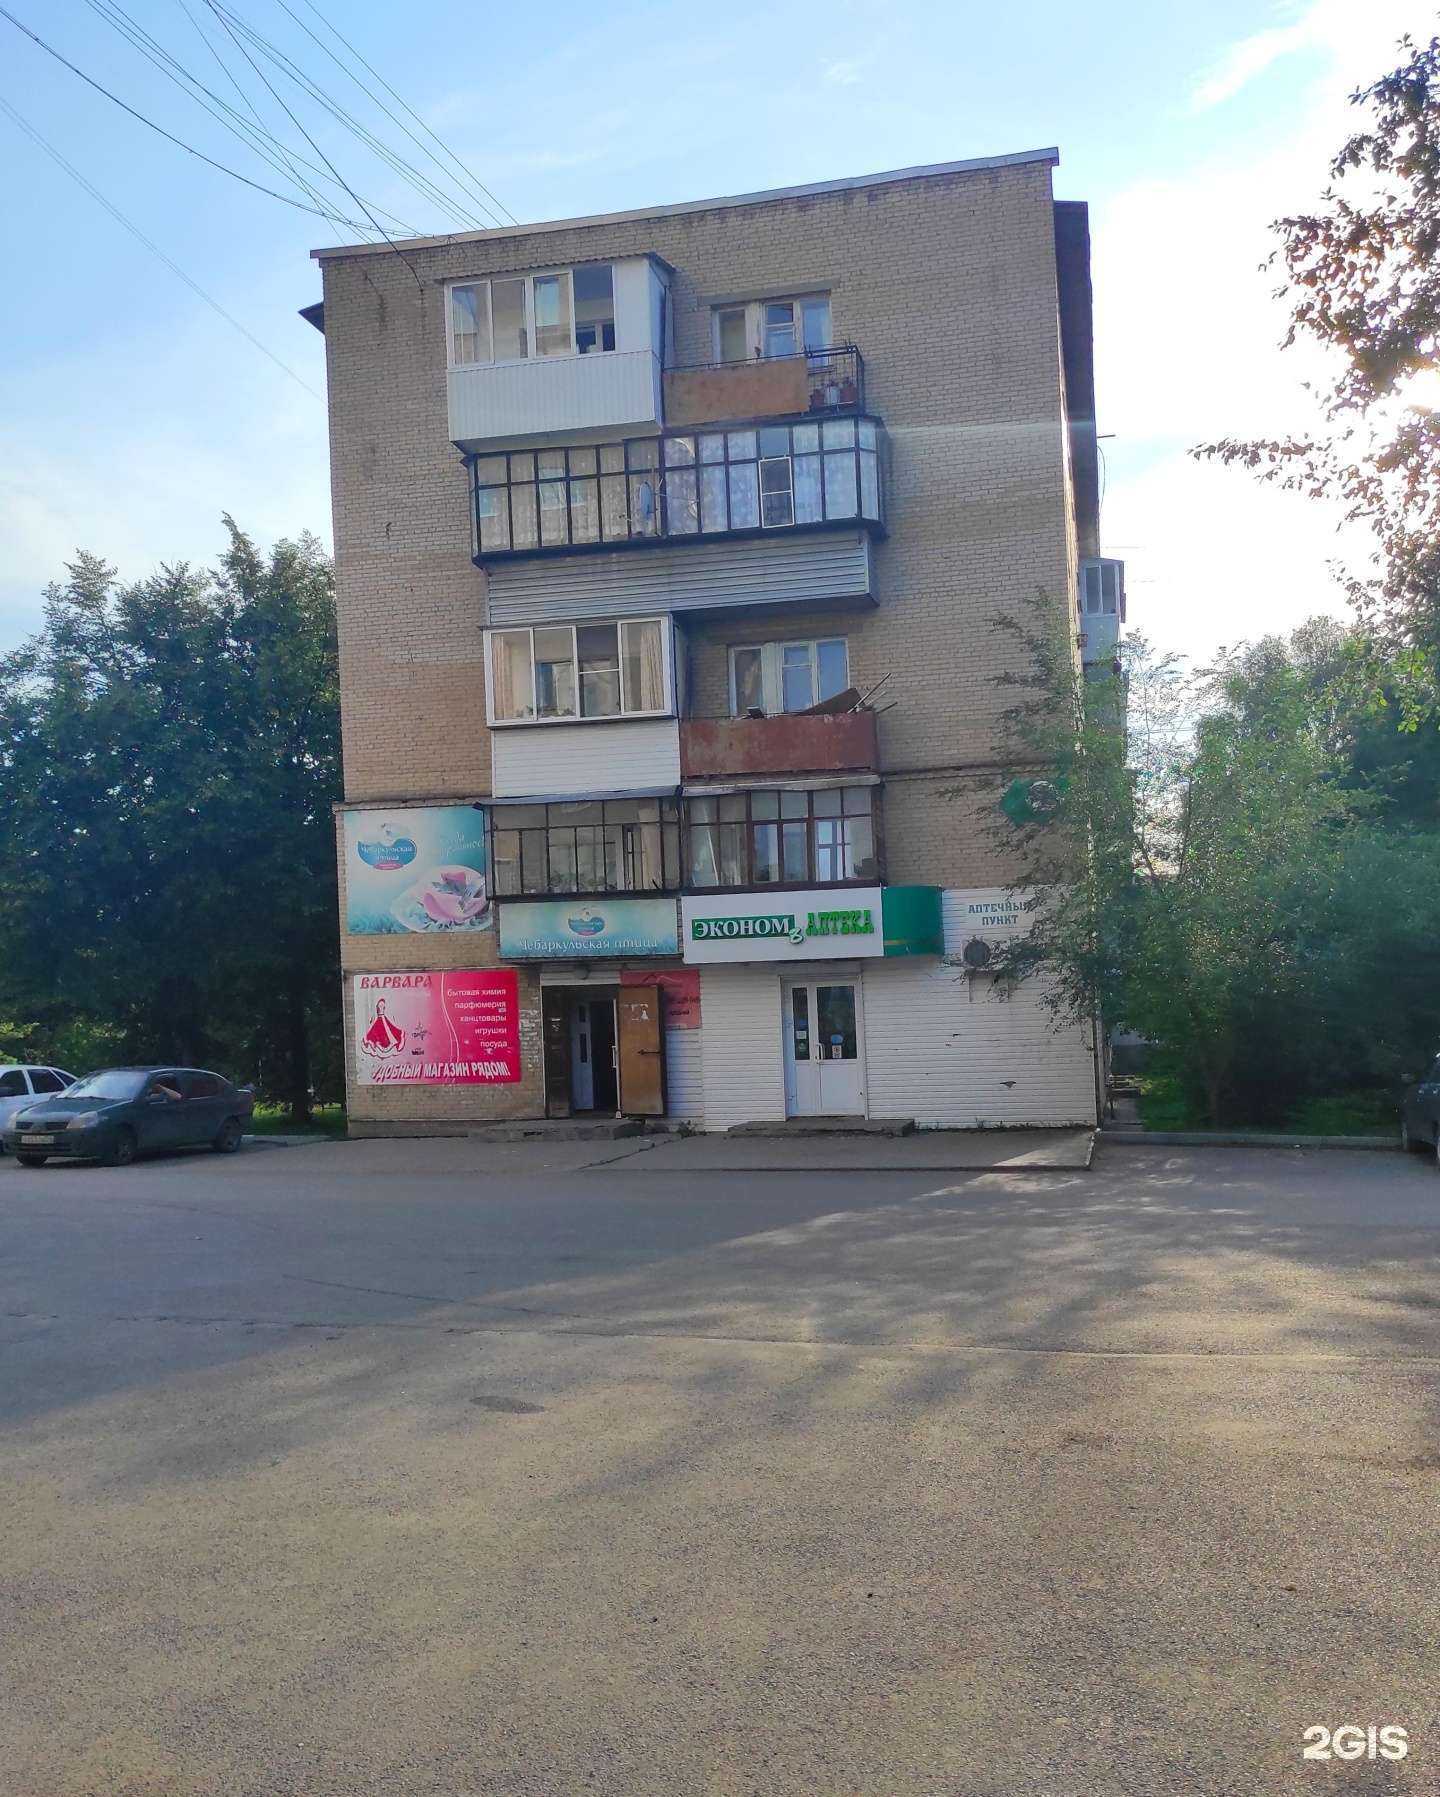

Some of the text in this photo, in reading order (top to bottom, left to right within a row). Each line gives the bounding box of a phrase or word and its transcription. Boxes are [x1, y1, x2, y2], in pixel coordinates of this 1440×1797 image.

[694, 918, 789, 938] ЭКОНОМ
[805, 910, 875, 936] АПТЕКА
[982, 914, 1018, 926] ПУНКТ
[520, 939, 609, 952] Чебаркульская
[360, 975, 432, 989] ВАРВАРА
[447, 989, 480, 997] бытовая
[454, 1001, 506, 1010] парфюмерия
[474, 1028, 507, 1036] игрушки
[480, 1041, 508, 1049] посуда
[423, 1060, 470, 1079] МАГАЗИН
[471, 1060, 511, 1079] РЯДОМ!
